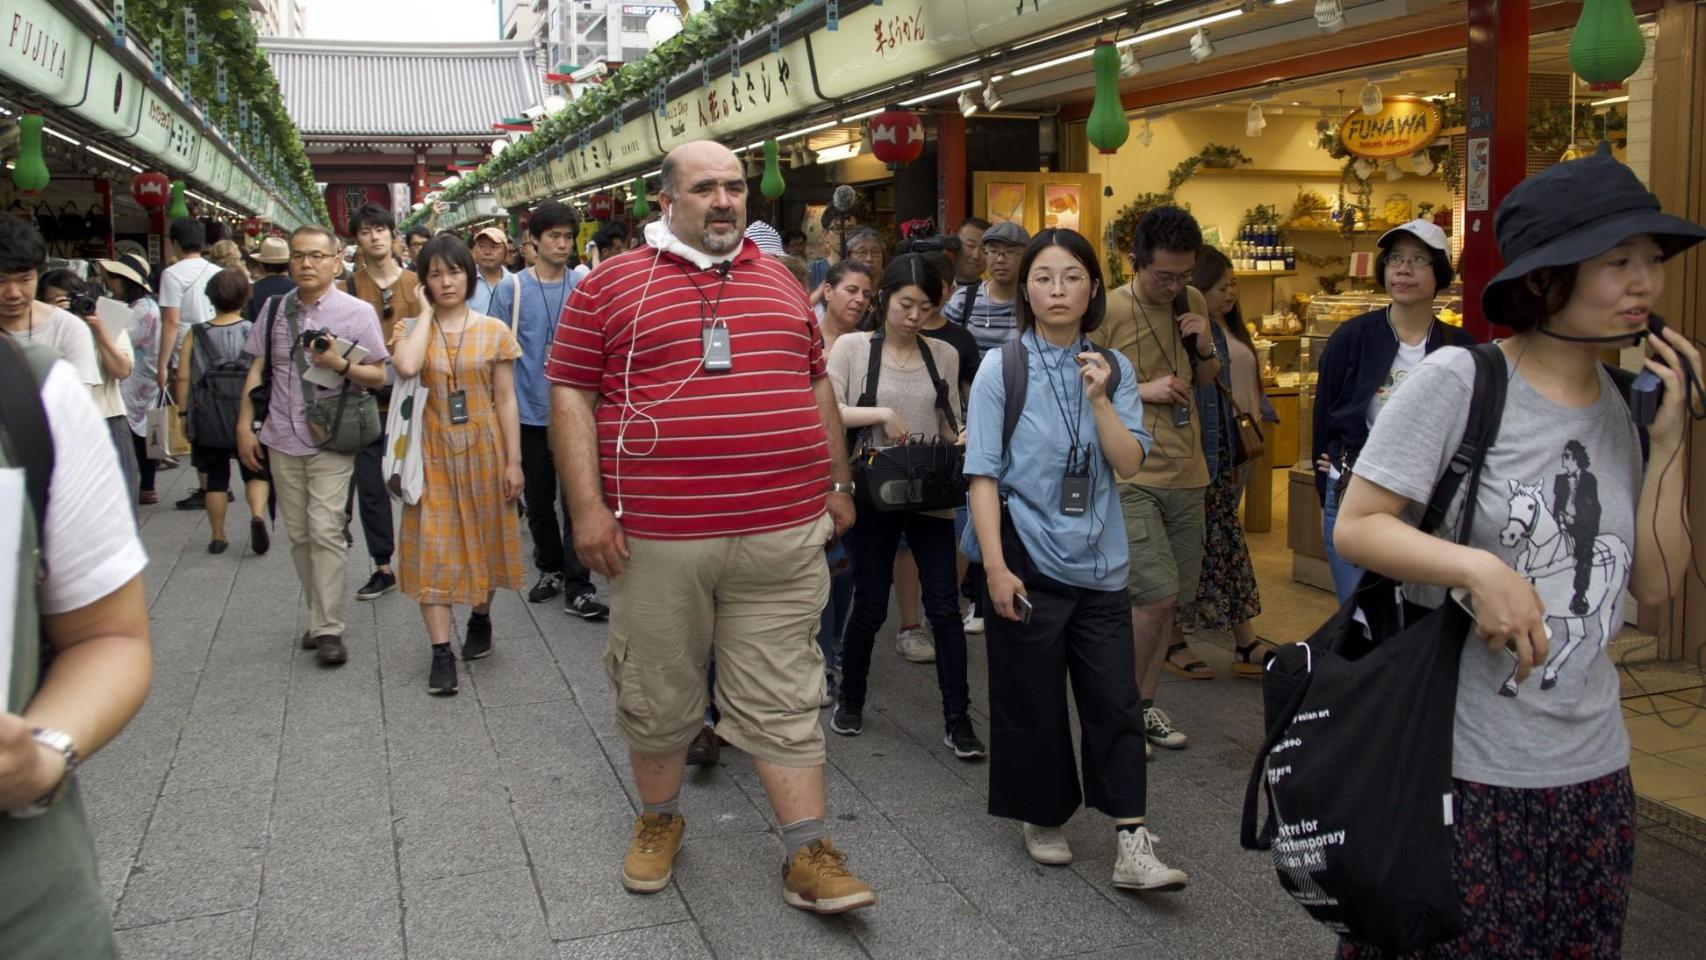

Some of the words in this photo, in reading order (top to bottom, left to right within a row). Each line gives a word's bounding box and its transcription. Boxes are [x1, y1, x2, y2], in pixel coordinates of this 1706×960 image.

[9, 12, 66, 79] FUJIYA
[1347, 111, 1427, 140] FUNAWA
[1298, 711, 1317, 721] asian
[1318, 709, 1330, 718] art
[1279, 823, 1300, 837] ntre
[1301, 819, 1318, 833] for
[1275, 829, 1346, 852] ontemporary
[1283, 855, 1301, 868] ian
[1304, 851, 1322, 866] Art
